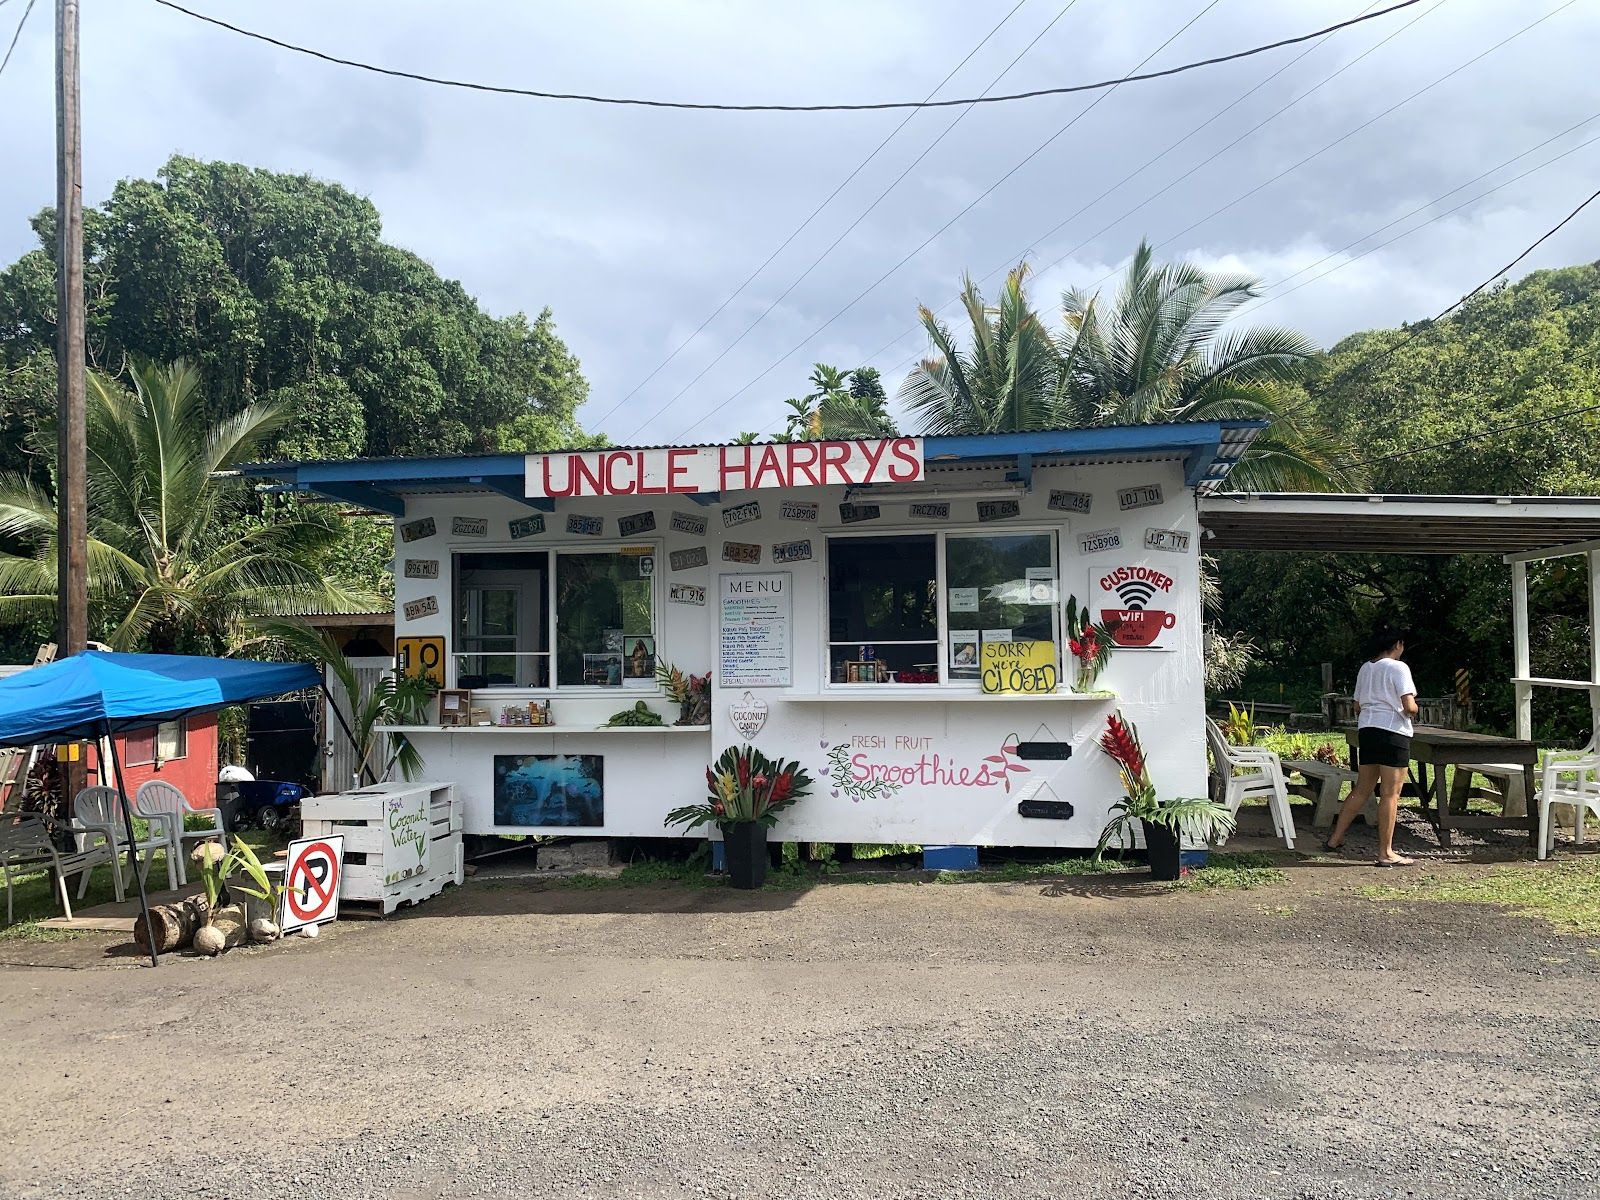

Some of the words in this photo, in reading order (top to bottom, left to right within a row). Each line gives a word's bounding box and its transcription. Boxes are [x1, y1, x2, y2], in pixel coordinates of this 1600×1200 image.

[542, 449, 698, 497] UNCLE
[720, 438, 920, 492] HARRY'S
[1050, 494, 1066, 507] MPL
[1072, 496, 1090, 509] 484
[1081, 535, 1121, 552] 7ZSB908
[407, 563, 421, 574] 996
[730, 580, 782, 593] MENU
[1100, 567, 1174, 593] CUSTOMER
[421, 600, 437, 613] 542
[1118, 612, 1144, 622] WIFI
[403, 643, 439, 669] 10
[986, 640, 1036, 657] SORRY
[992, 660, 1024, 670] we're
[983, 664, 1056, 693] CLOSED
[733, 711, 767, 721] COCONUT
[739, 722, 760, 730] CANDY
[851, 735, 886, 749] FRESH
[895, 735, 934, 751] FRUIT
[851, 753, 999, 787] Smoothies
[389, 800, 427, 831] Coconut
[391, 825, 422, 848] Water
